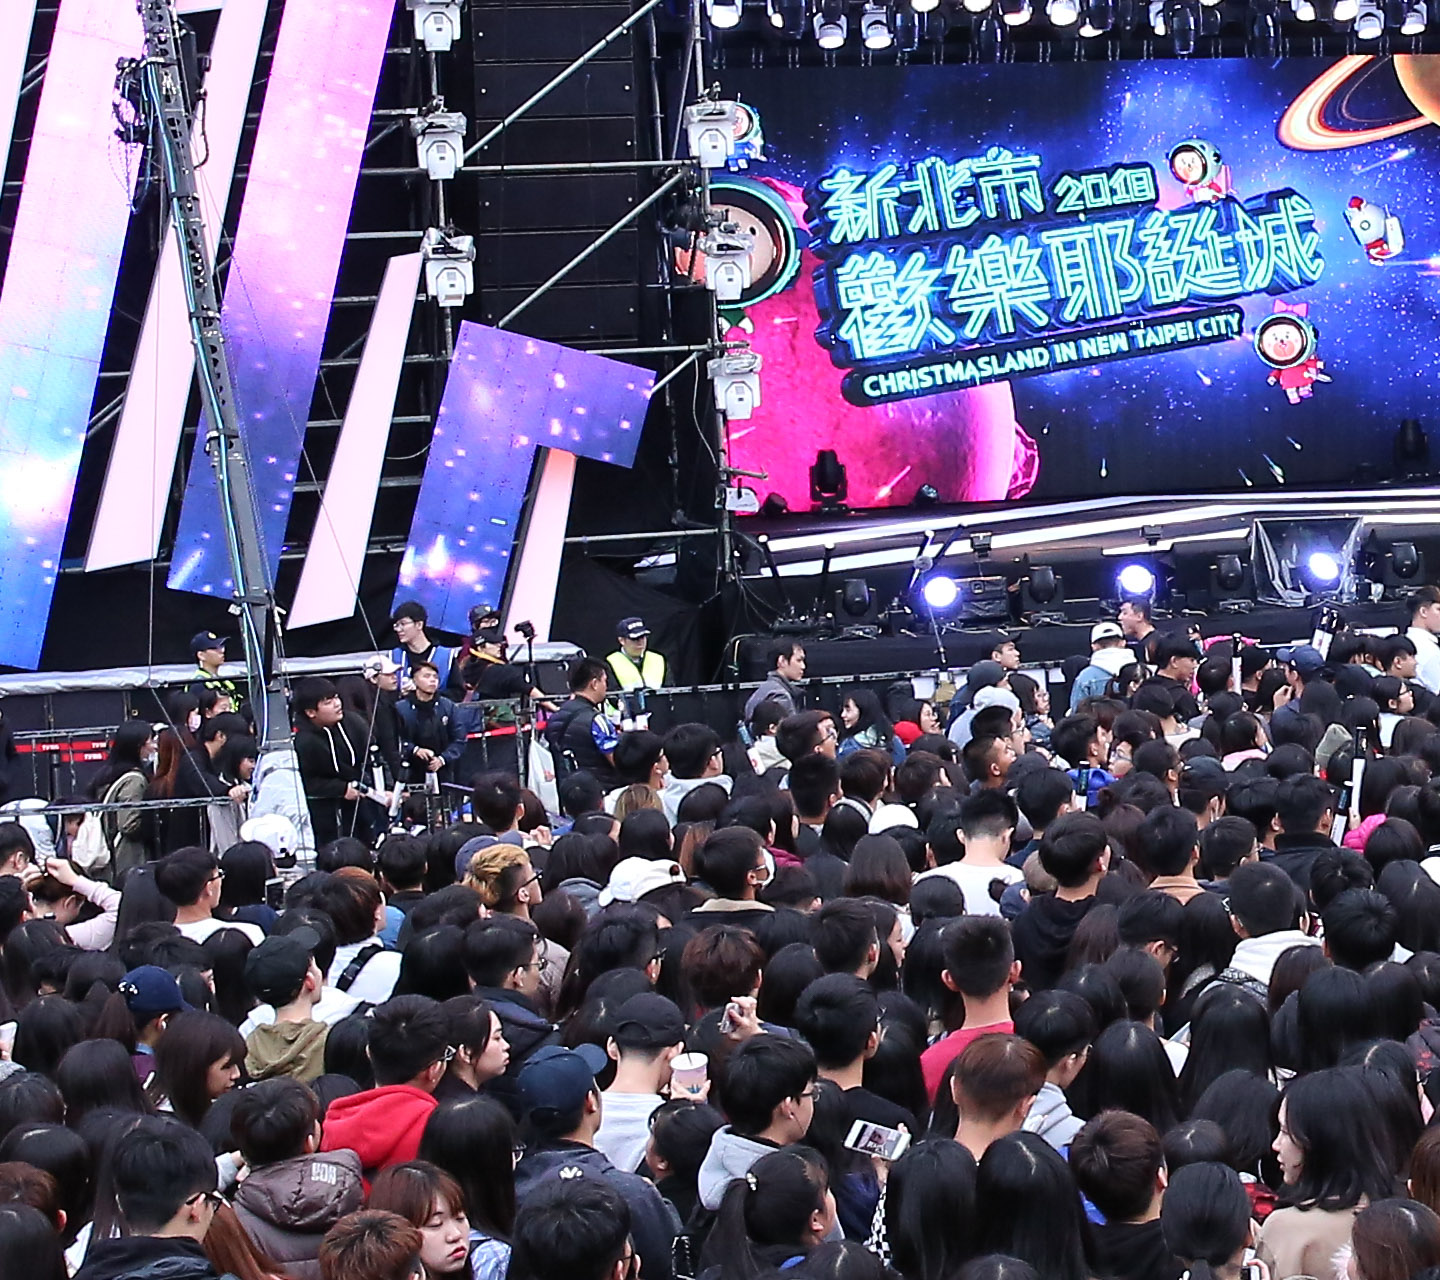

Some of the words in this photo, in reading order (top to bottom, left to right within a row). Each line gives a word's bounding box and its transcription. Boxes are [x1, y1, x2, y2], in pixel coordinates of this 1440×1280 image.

[820, 148, 1046, 244] 新北市
[1053, 166, 1157, 214] 2018
[836, 197, 1326, 360] 歡樂耶誕城
[862, 349, 1050, 398] CHRISTMASLAND
[1055, 344, 1078, 365] IN
[1134, 324, 1195, 352] TAIPEI
[1199, 313, 1241, 341] CITY
